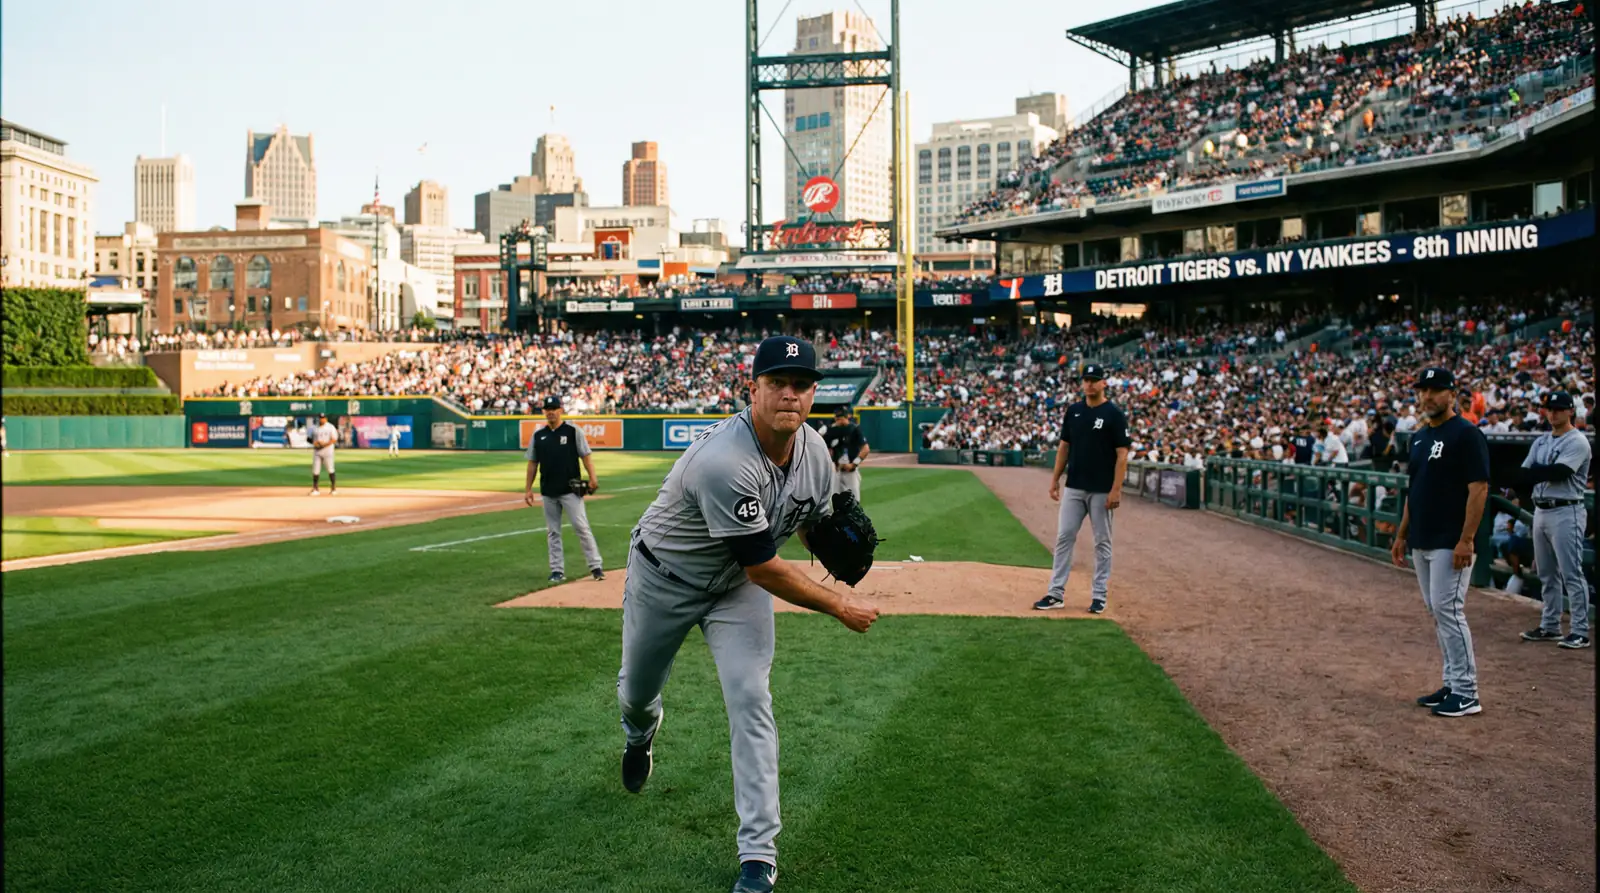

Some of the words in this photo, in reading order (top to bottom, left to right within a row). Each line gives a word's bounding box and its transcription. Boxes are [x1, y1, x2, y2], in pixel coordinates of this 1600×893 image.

[1095, 263, 1165, 290] DETROIT
[1168, 257, 1231, 284] TIGERS
[1235, 258, 1262, 276] vs.
[1266, 250, 1294, 274] NY
[1299, 239, 1392, 270] YANKEES
[1413, 234, 1449, 260] 8th
[1456, 224, 1538, 255] INNING
[785, 342, 800, 358] D
[1428, 439, 1445, 461] D
[736, 500, 760, 518] 45
